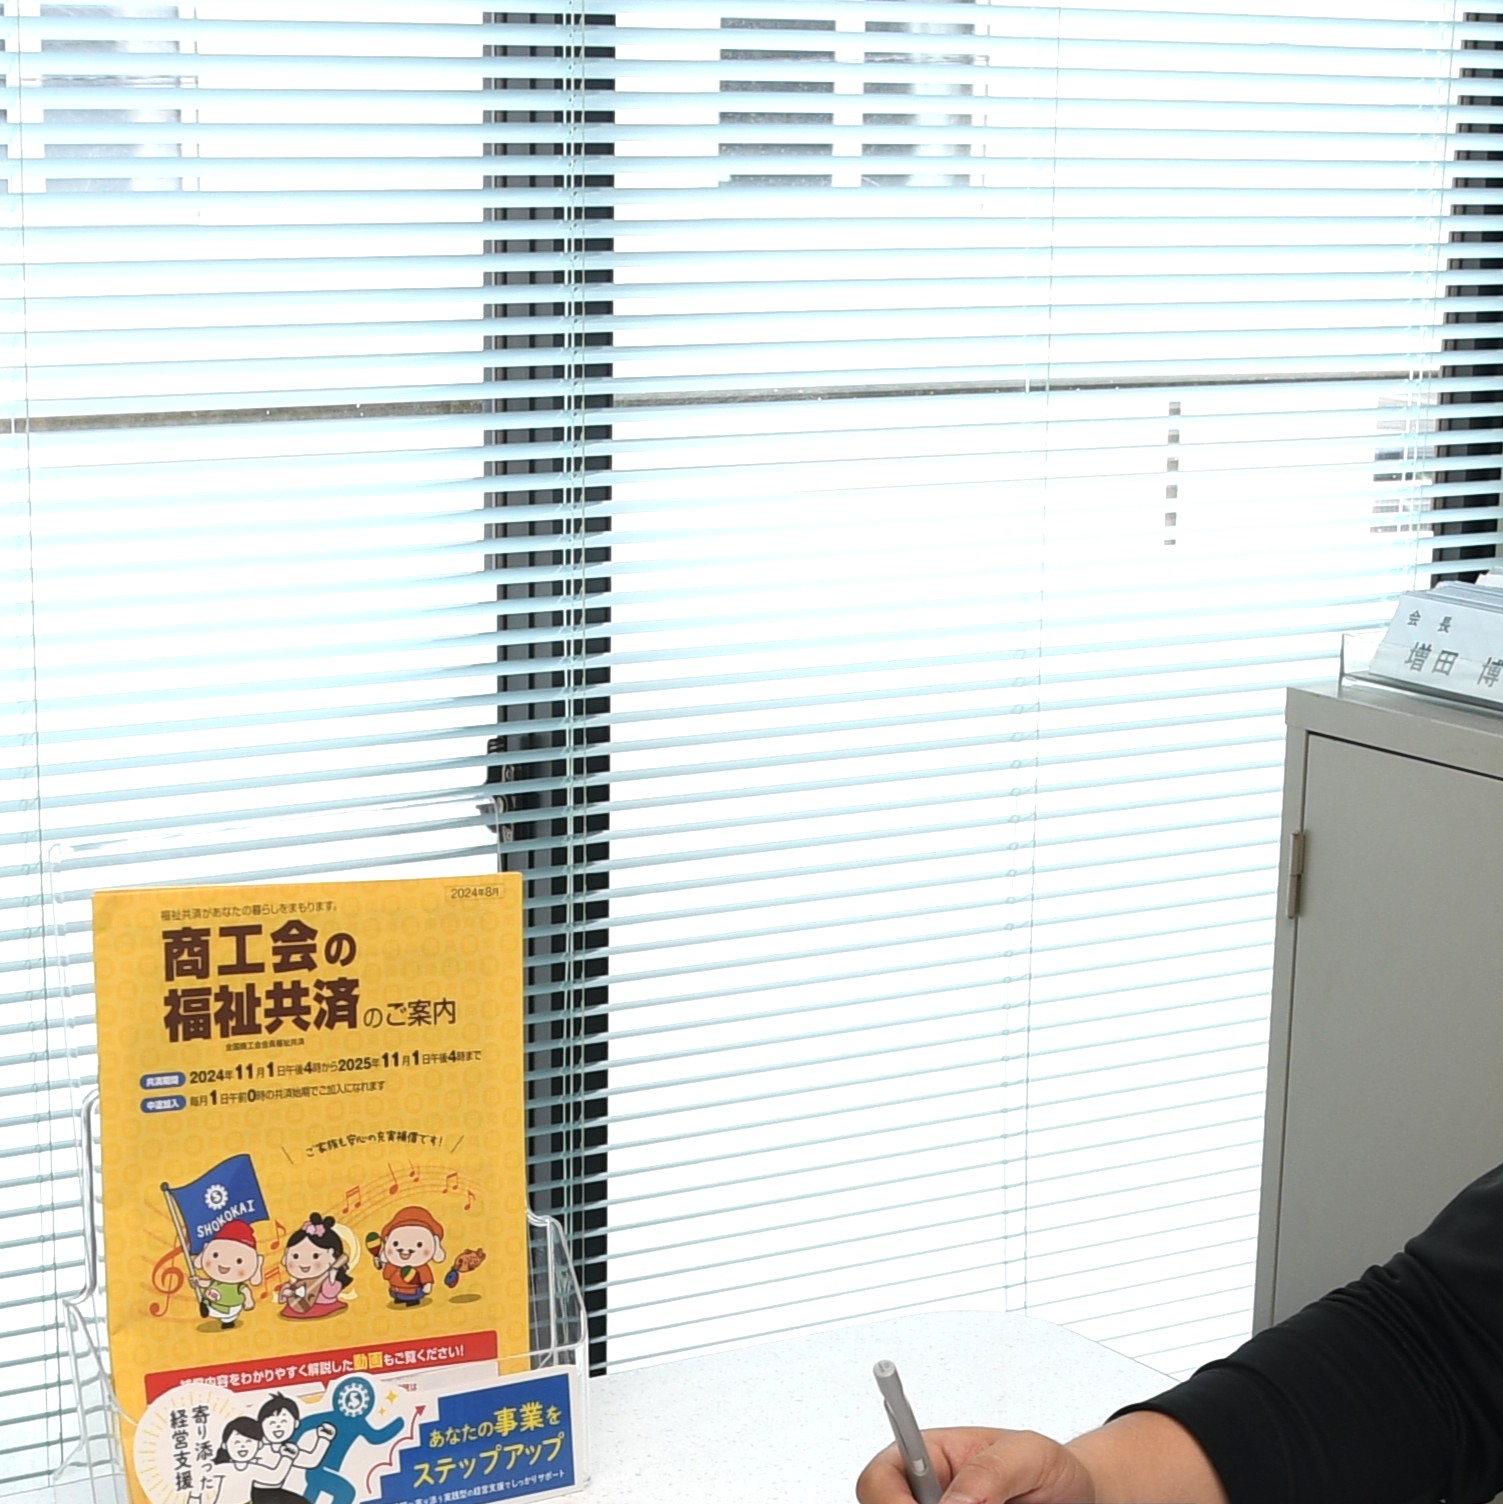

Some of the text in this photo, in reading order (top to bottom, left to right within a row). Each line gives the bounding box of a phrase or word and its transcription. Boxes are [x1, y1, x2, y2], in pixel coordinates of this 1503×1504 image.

[1404, 642, 1460, 678] 増田
[161, 902, 337, 920] 福祉共済があなたの暮らしをまもります。
[450, 886, 499, 899] 2024年8月
[163, 920, 357, 981] 商工会の
[164, 979, 456, 1042] 福祉共済のご案内
[197, 1199, 255, 1238] SHOKOKAI
[192, 1405, 213, 1490] 寄り添った
[429, 1406, 561, 1447] あなたの事業を
[170, 1409, 193, 1491] 経営支援
[413, 1437, 565, 1488] ステップアップ
